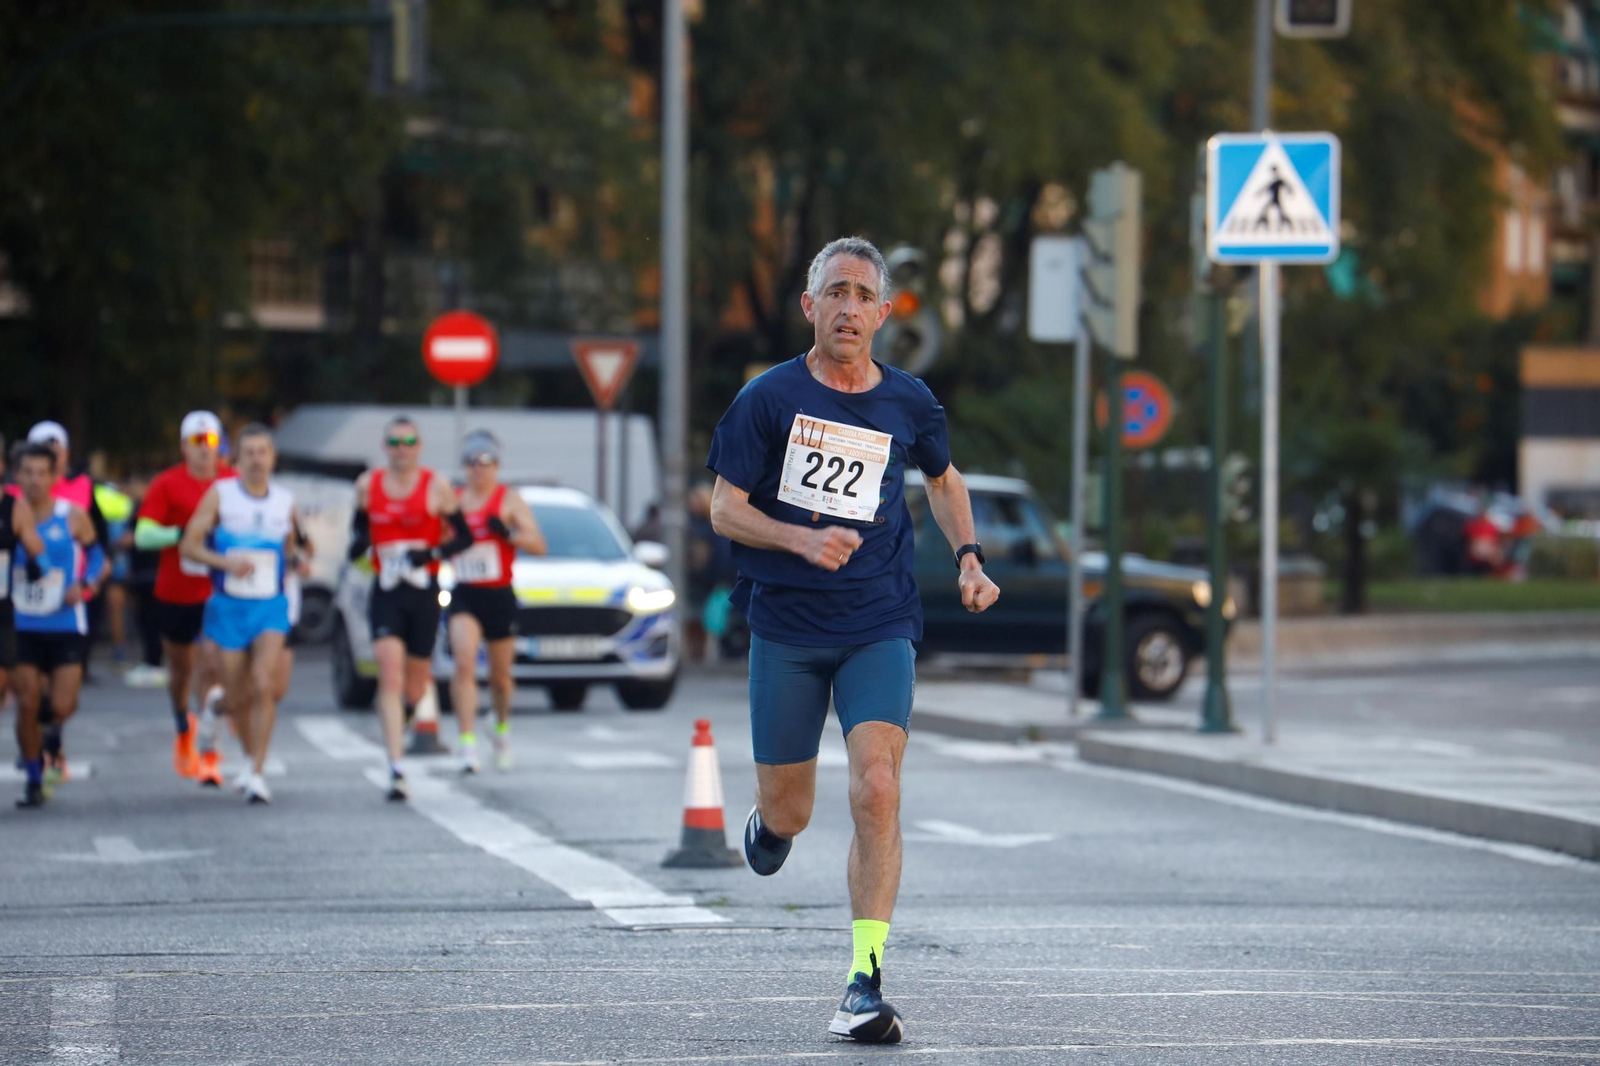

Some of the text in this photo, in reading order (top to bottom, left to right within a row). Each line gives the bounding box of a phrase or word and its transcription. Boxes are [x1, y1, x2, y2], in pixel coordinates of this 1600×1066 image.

[793, 417, 827, 450] XLI
[837, 427, 877, 442] CARRERA POPULAR
[823, 444, 847, 455] MEMORIAL
[846, 439, 862, 448] TRINIDAD
[800, 451, 865, 498] 222
